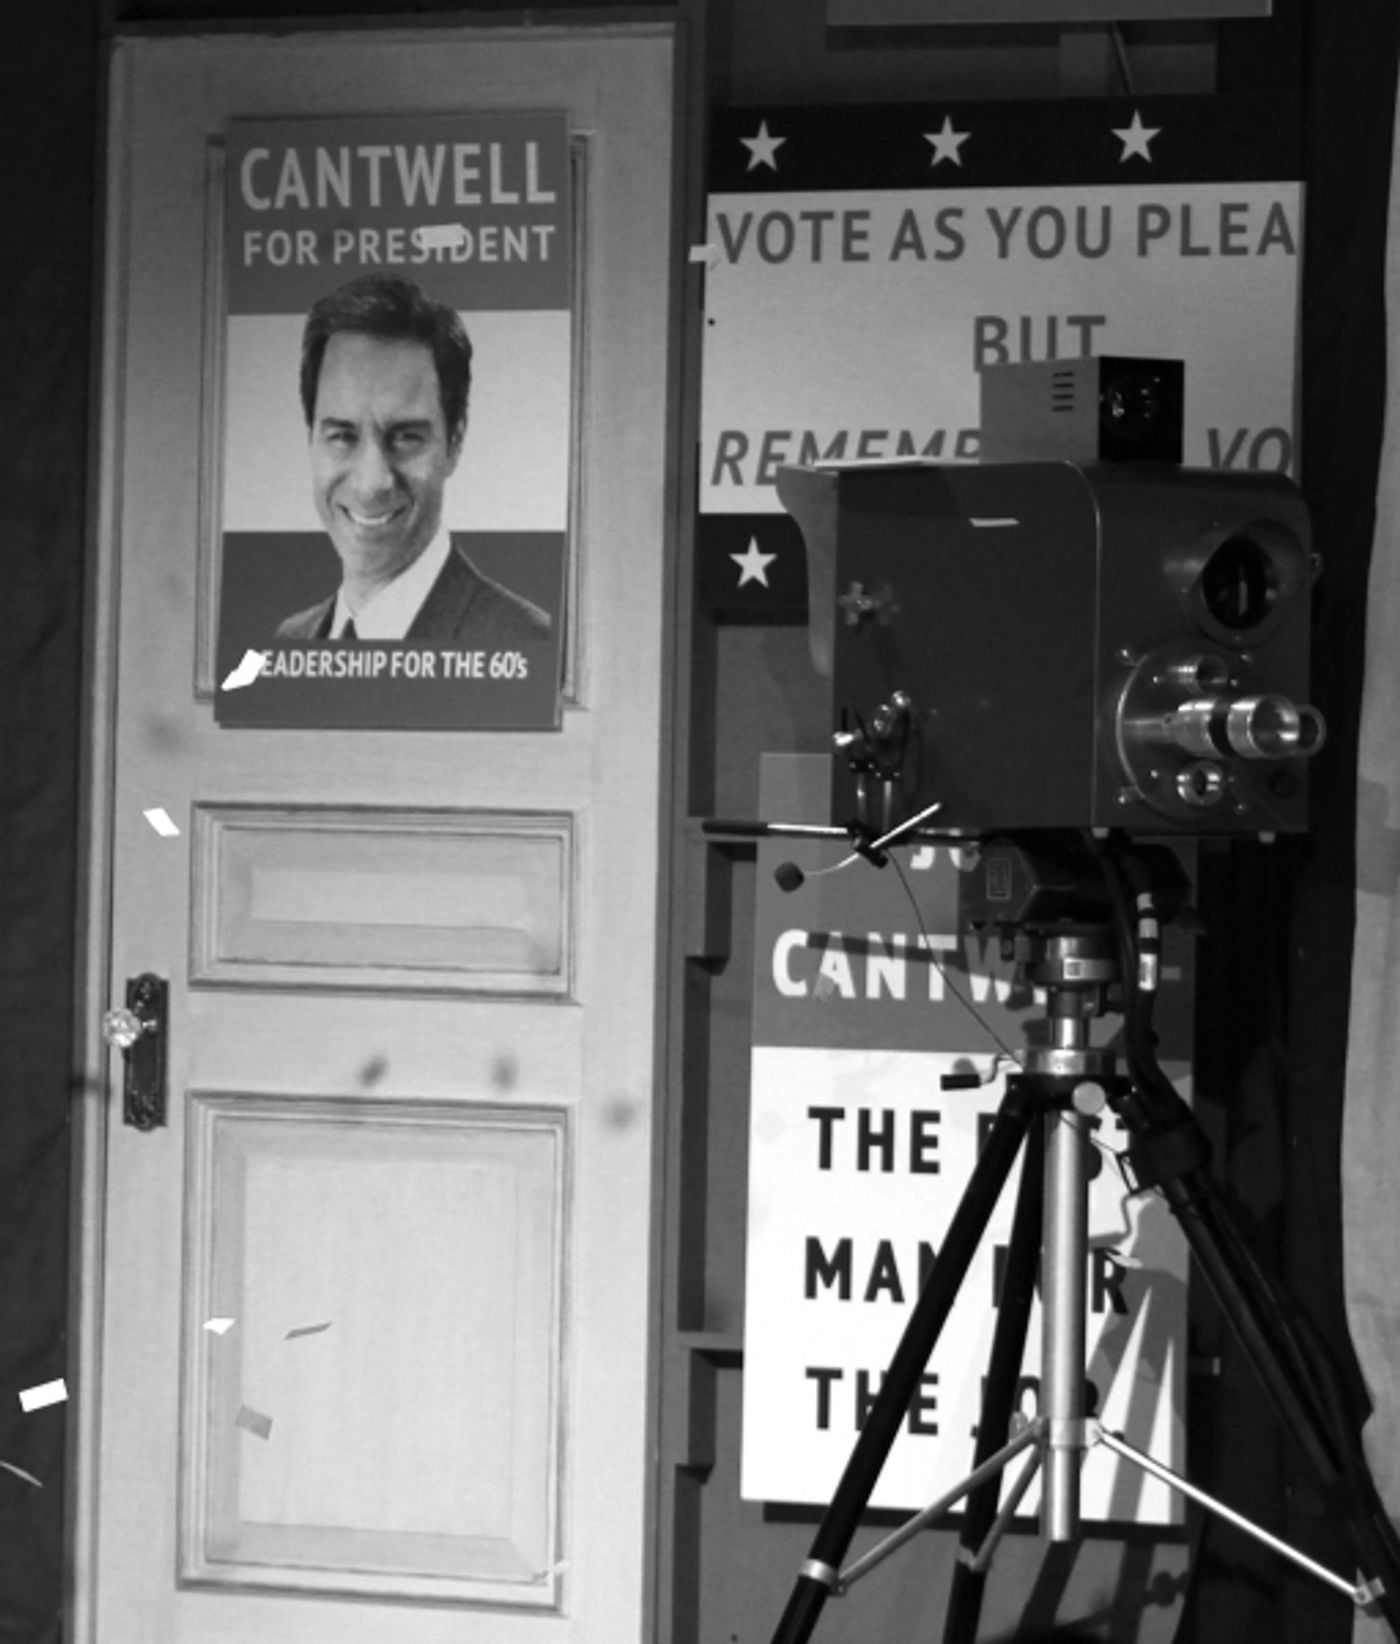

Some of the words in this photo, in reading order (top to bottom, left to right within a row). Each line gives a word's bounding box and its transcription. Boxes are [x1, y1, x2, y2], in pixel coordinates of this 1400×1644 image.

[240, 141, 557, 211] CANTWELL
[243, 230, 319, 267] FOR
[716, 209, 871, 264] VOTE
[888, 207, 965, 262] AS
[986, 205, 1112, 259] YOU
[1136, 201, 1297, 258] PLEA
[973, 315, 1106, 372] BUT
[258, 650, 387, 678] EADERSHIP
[391, 652, 435, 679] FOR
[441, 652, 485, 679] THE
[771, 928, 1049, 1004] CANTW
[807, 1106, 942, 1175] THE
